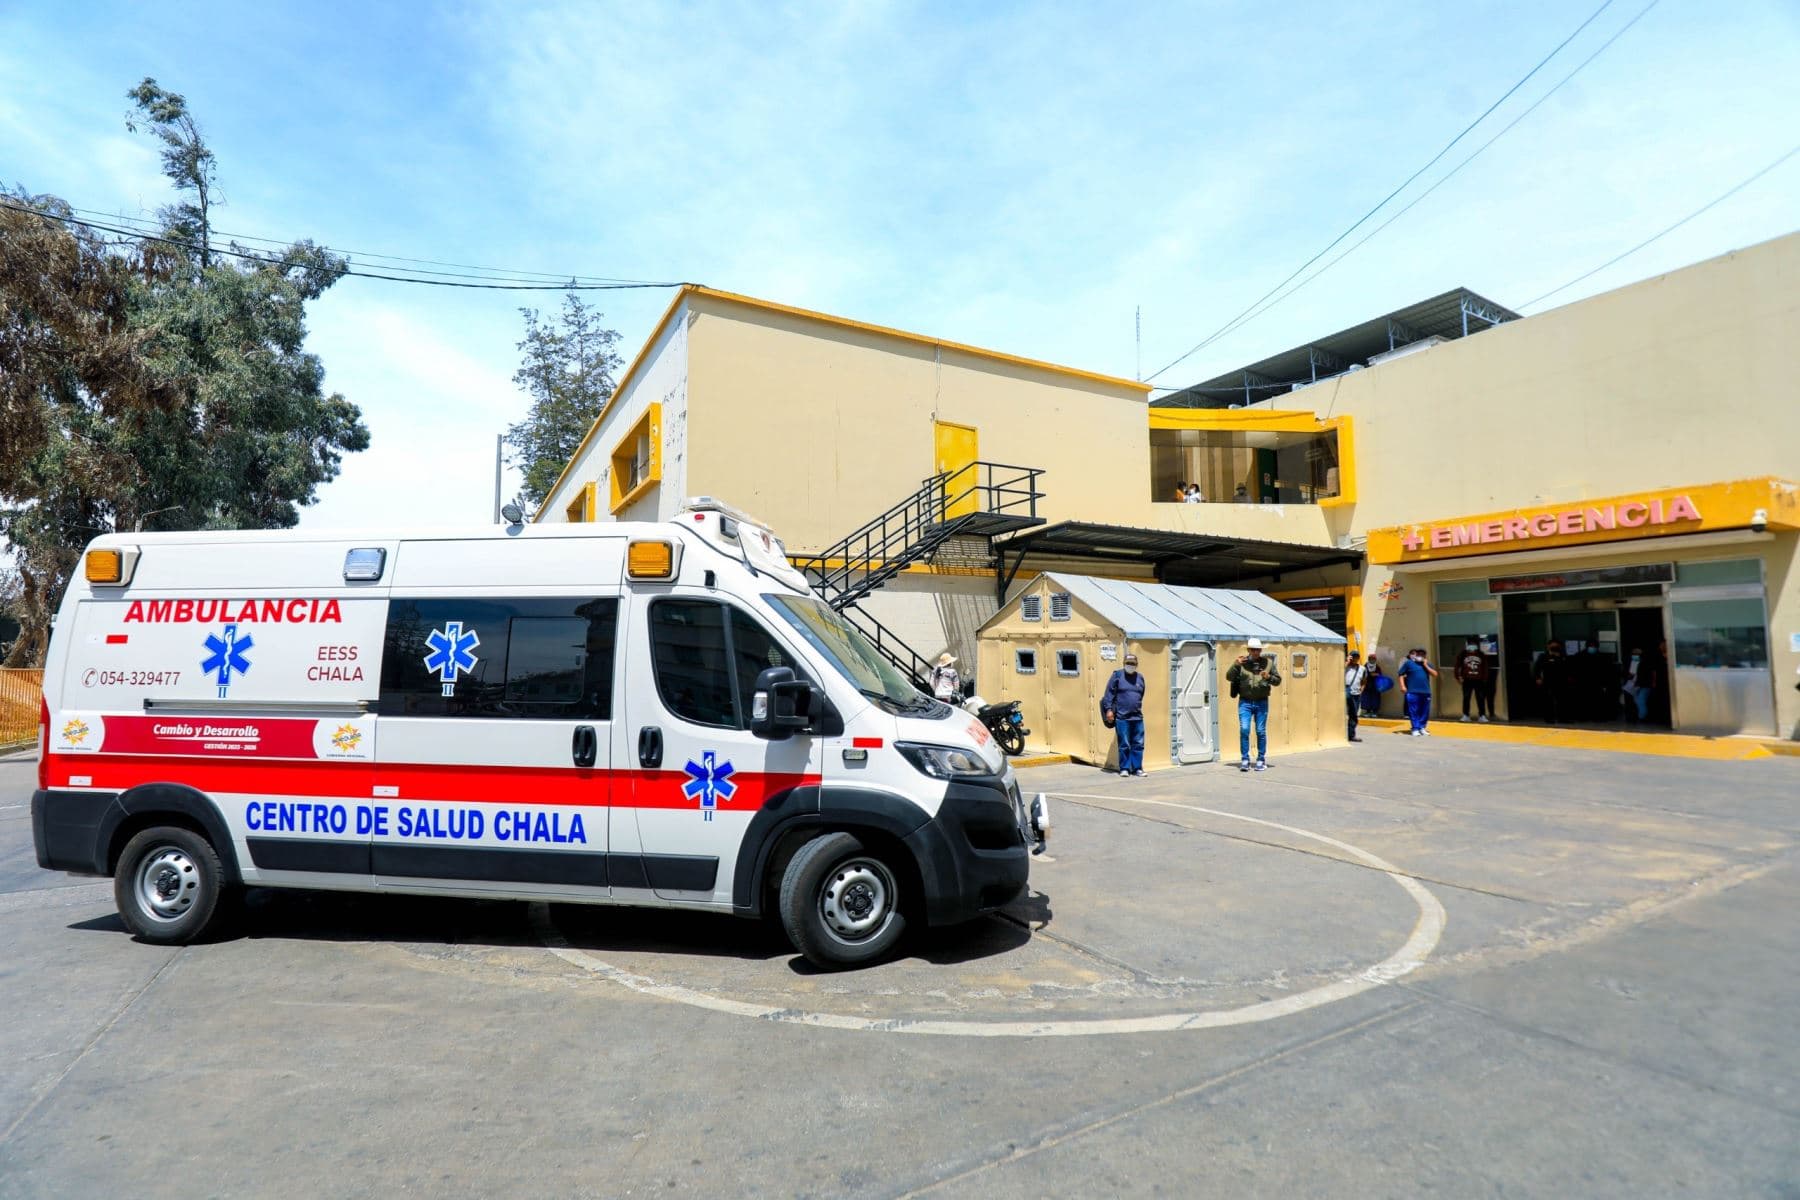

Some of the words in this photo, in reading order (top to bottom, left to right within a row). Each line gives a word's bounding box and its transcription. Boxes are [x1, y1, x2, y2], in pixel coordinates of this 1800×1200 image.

[1430, 495, 1702, 549] EMERGENCIA
[124, 599, 342, 623] AMBULANCIA
[317, 646, 358, 661] EESS
[99, 671, 181, 686] 054-329477
[307, 666, 364, 682] CHALA
[153, 724, 193, 735] Cambio
[194, 727, 202, 738] y
[203, 725, 259, 737] Desarrollo
[246, 802, 347, 834] CENTRO
[356, 806, 389, 836] DE
[397, 808, 484, 840] SALUD
[494, 811, 587, 844] CHALA
